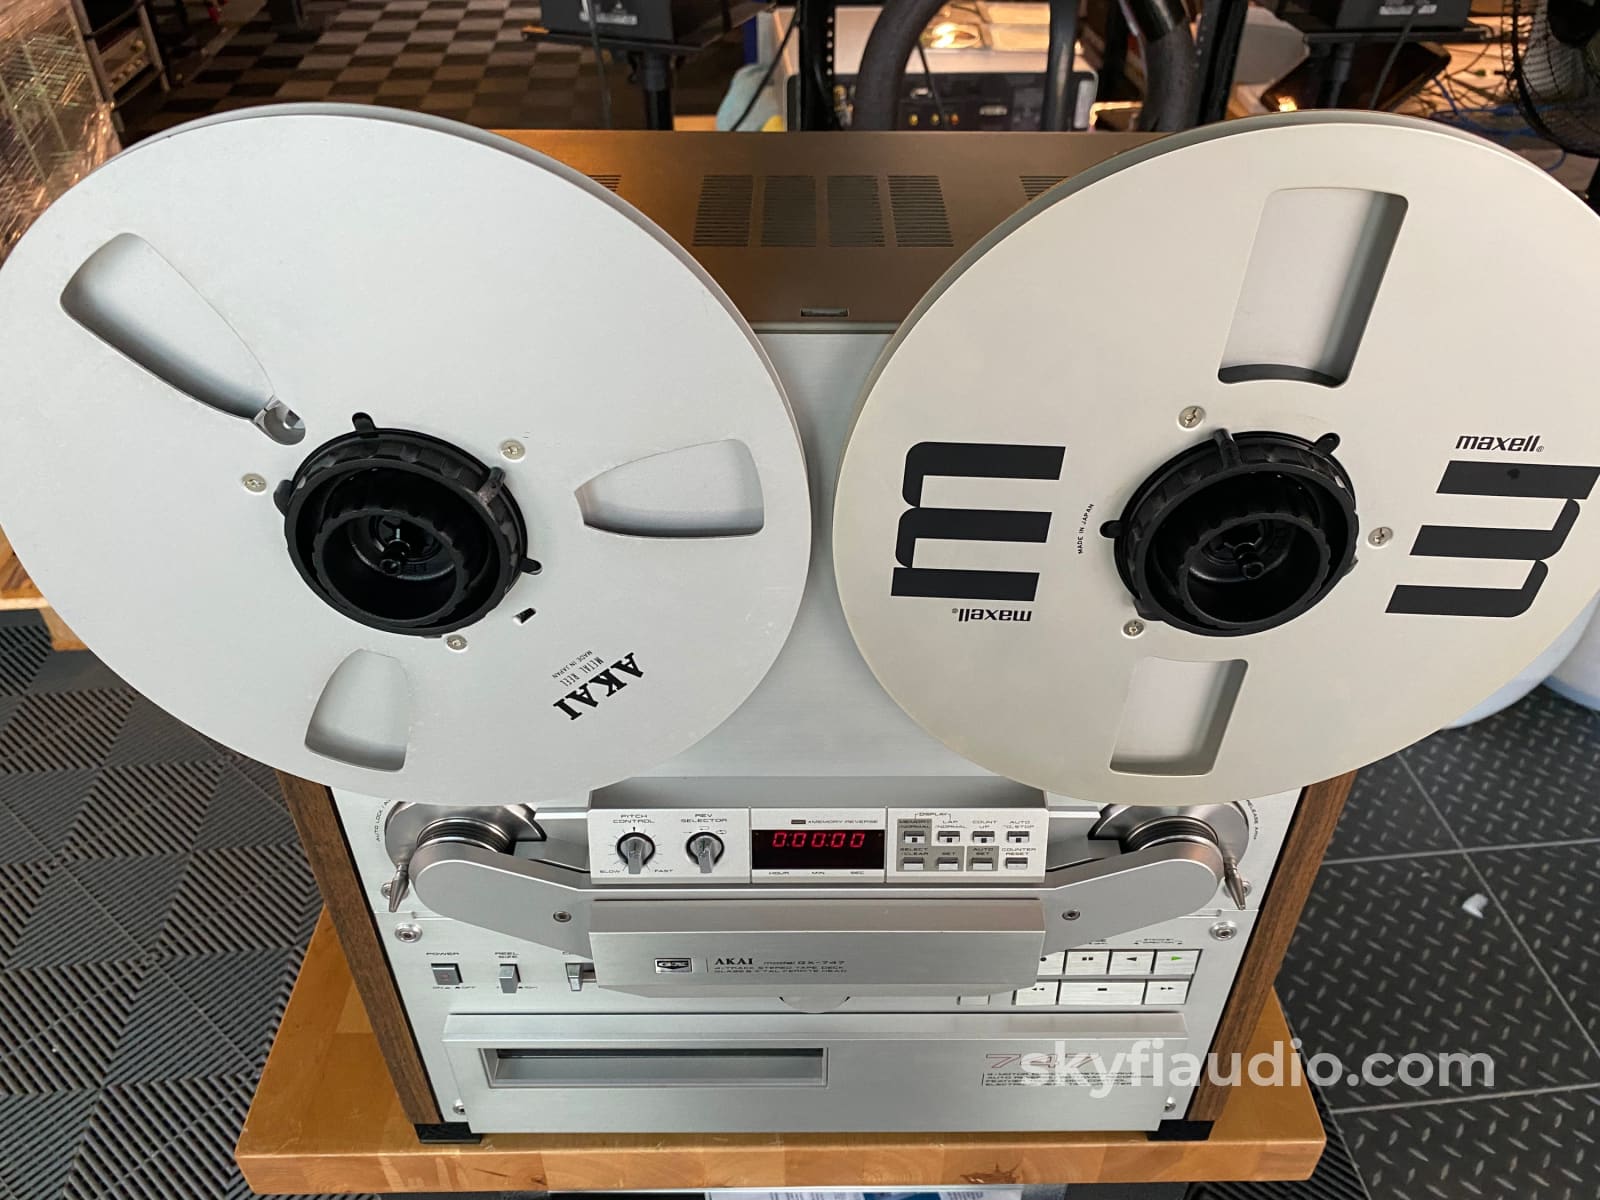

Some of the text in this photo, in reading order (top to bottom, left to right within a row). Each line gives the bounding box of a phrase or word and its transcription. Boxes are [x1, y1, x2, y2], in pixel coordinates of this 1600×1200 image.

[1455, 435, 1541, 452] maxell
[957, 608, 1032, 622] maxell
[579, 656, 604, 674] METAL
[553, 652, 644, 720] AKAI
[714, 957, 754, 966] AKAI
